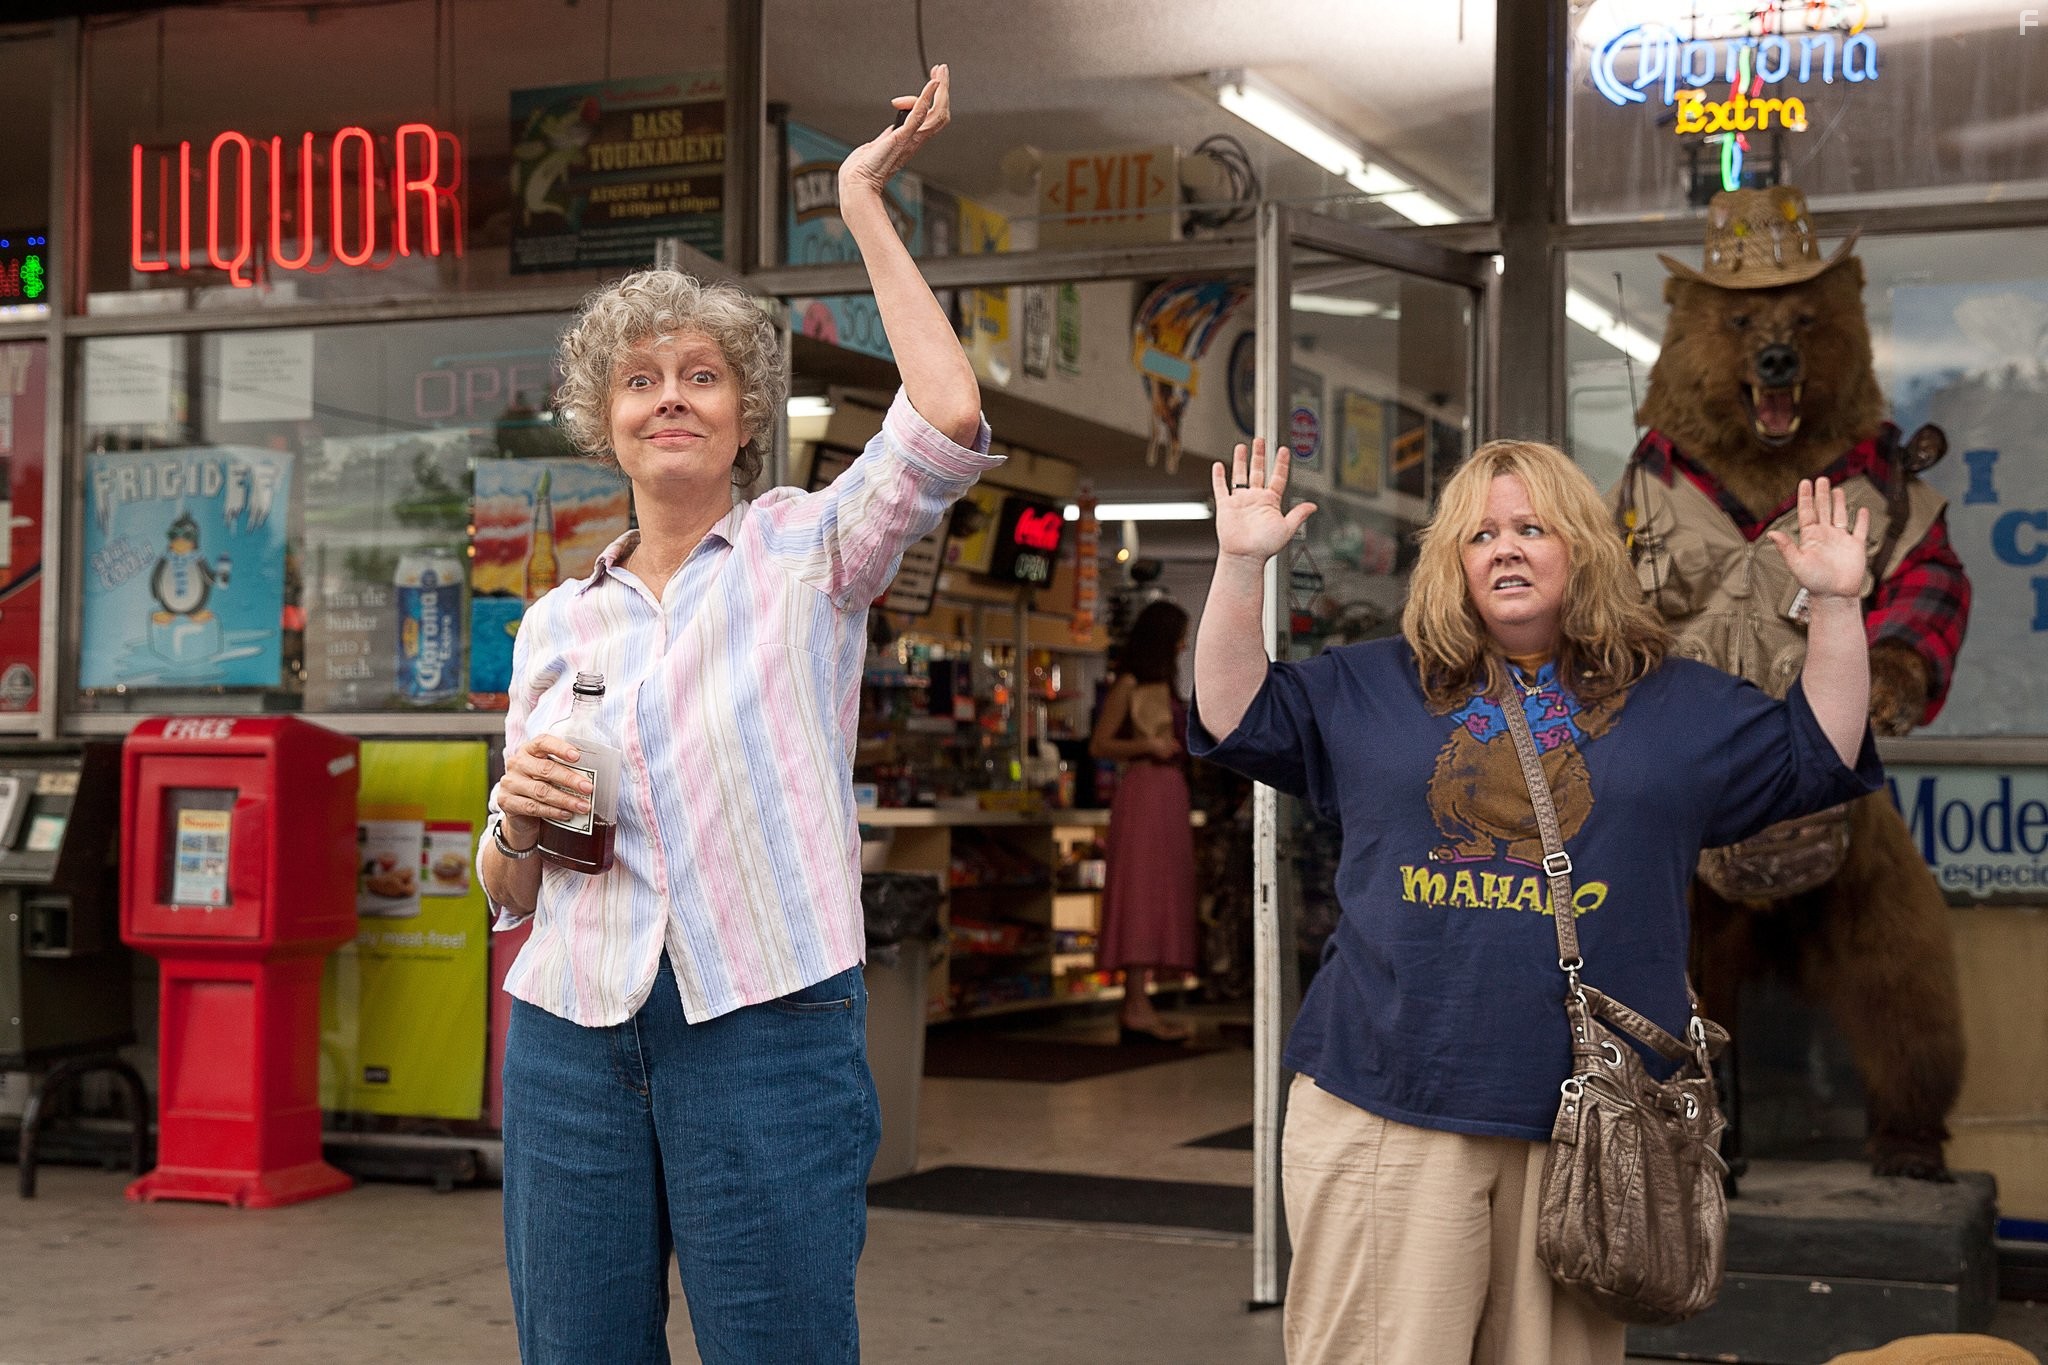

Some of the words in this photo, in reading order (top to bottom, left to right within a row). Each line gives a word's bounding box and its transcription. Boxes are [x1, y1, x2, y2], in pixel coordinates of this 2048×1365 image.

[1590, 24, 1879, 106] Corona
[631, 109, 683, 140] BASS
[1674, 88, 1809, 134] Extra
[588, 132, 725, 171] TOURNAMENT
[131, 122, 440, 288] LIQUOR
[1065, 152, 1153, 226] EXIT
[415, 592, 444, 690] Corona
[162, 718, 238, 740] FREE
